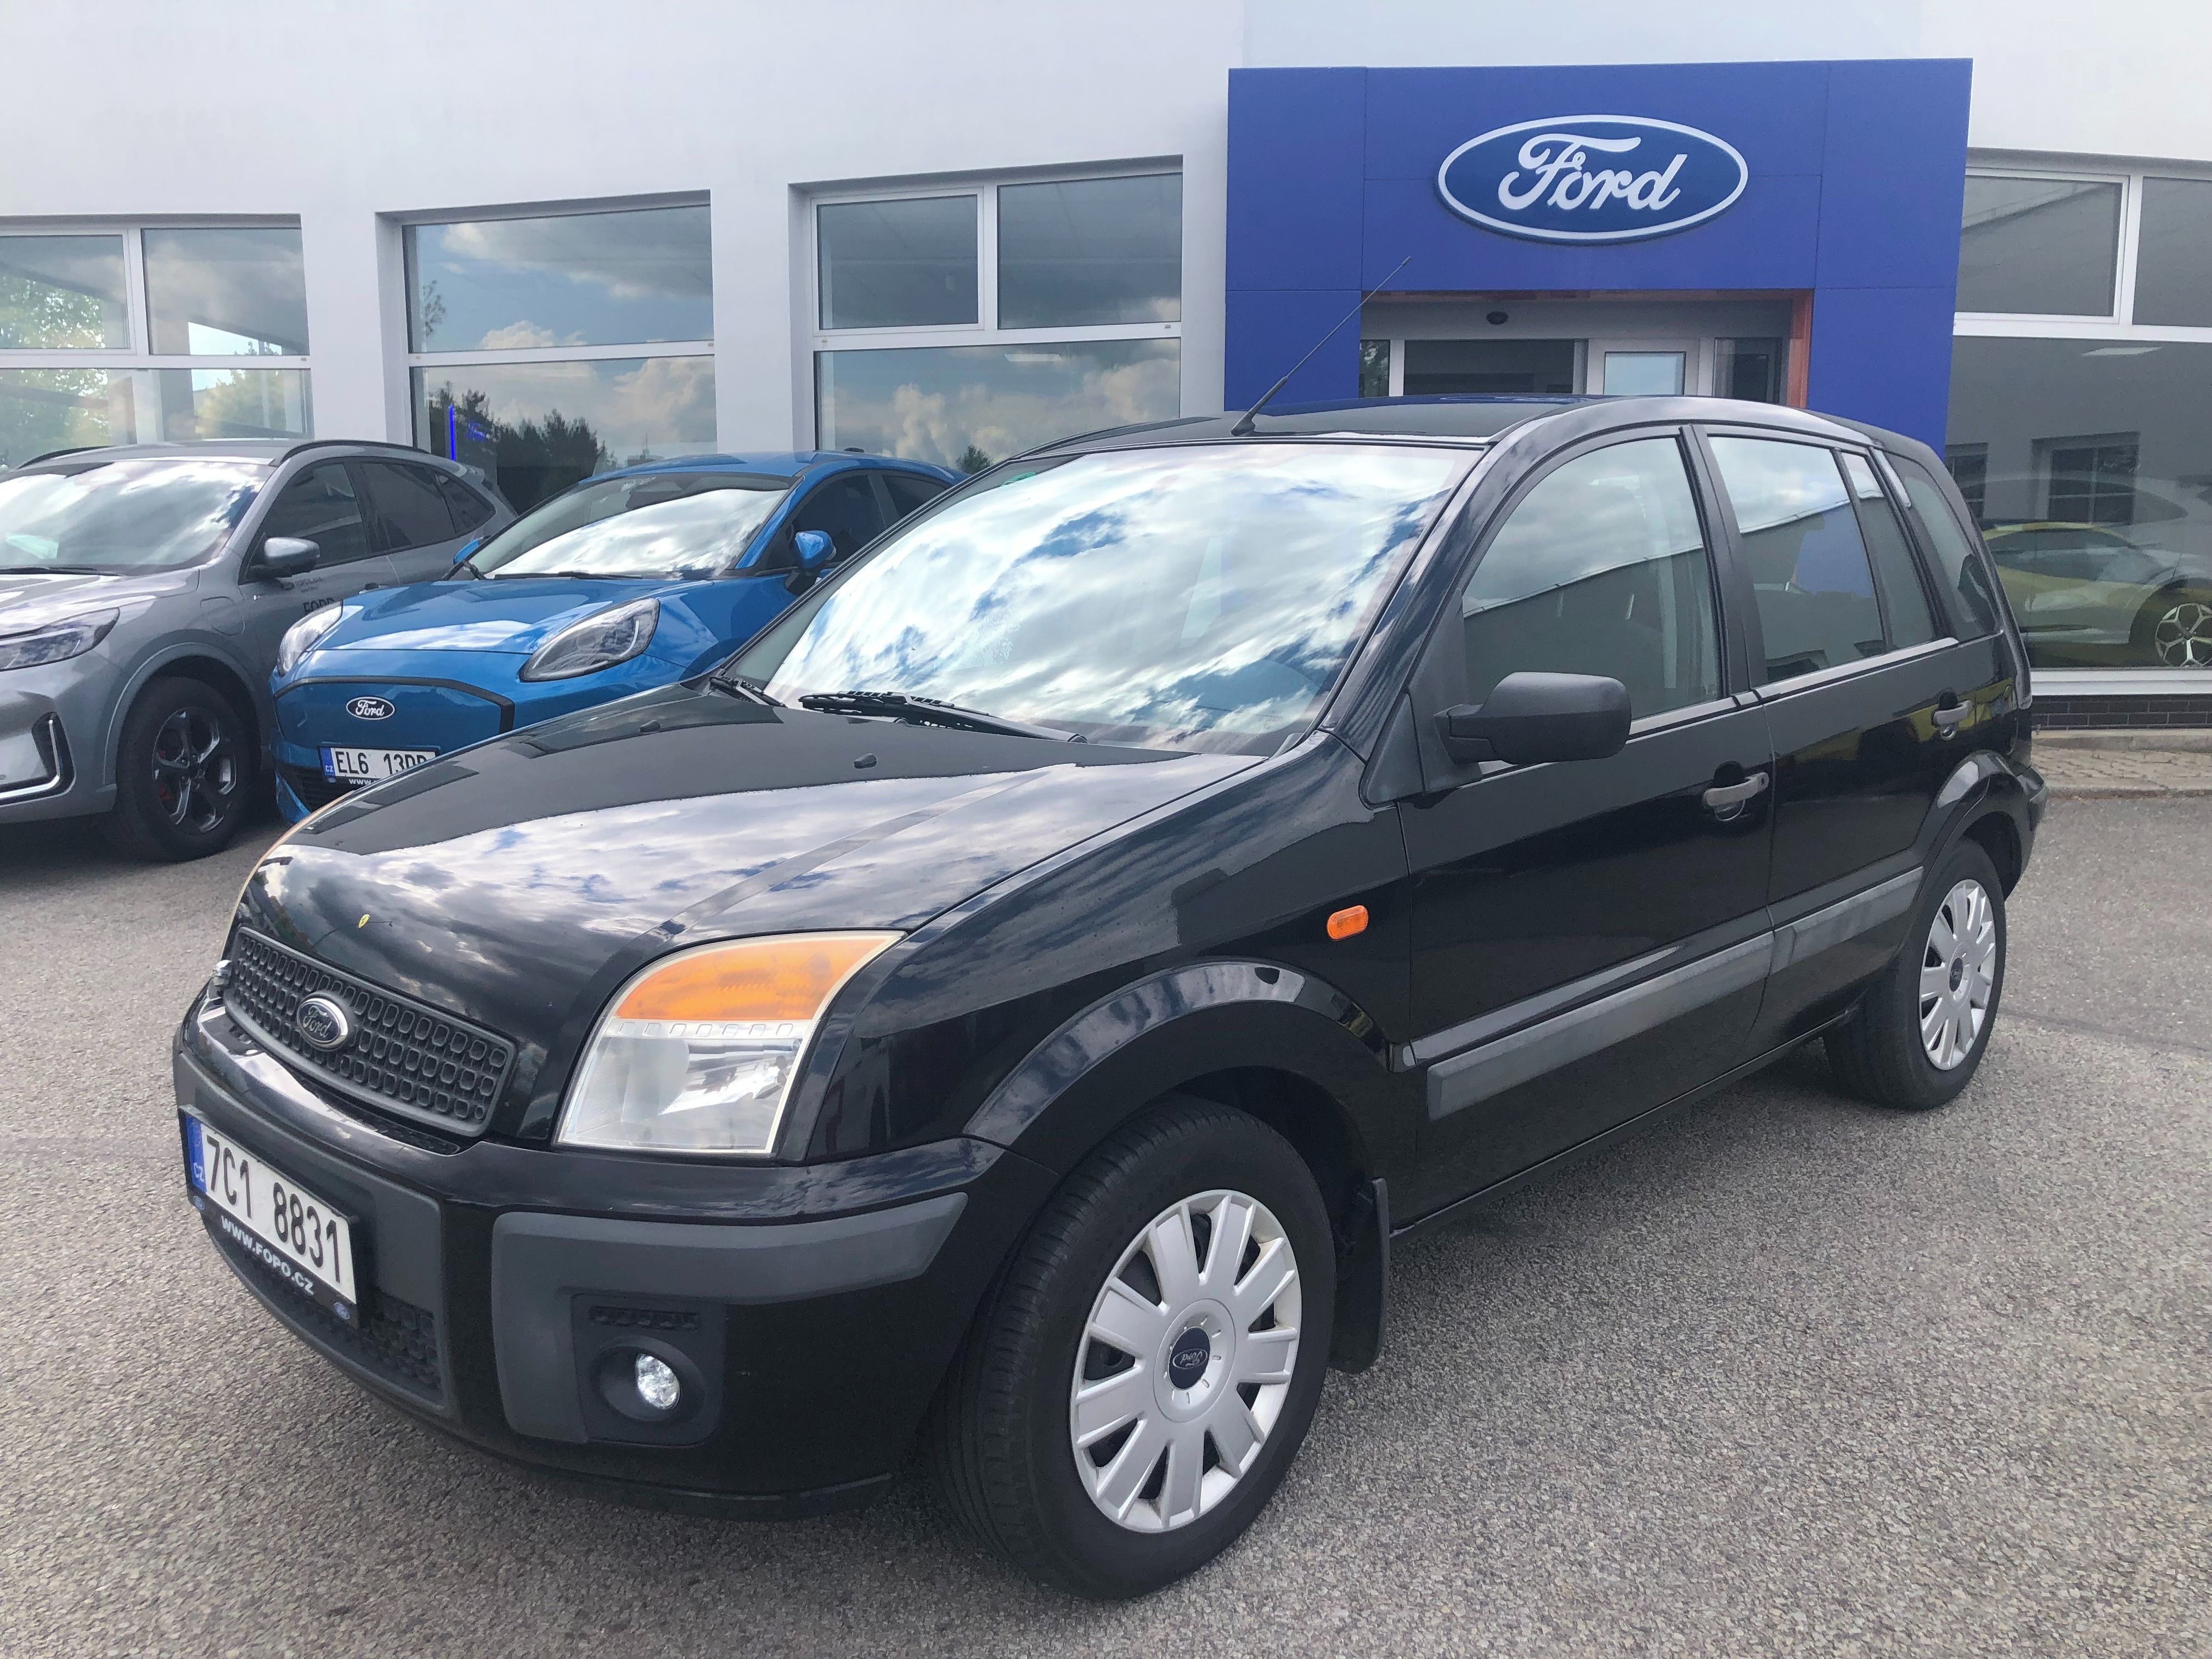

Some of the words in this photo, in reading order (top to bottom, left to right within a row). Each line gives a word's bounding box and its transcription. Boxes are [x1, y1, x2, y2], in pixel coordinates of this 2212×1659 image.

[1498, 133, 1688, 211] Ford
[355, 699, 385, 716] Ford
[335, 751, 369, 775] EL6
[303, 1005, 332, 1038] Ford
[194, 1162, 204, 1182] CZ
[206, 1134, 252, 1219] 7C1
[273, 1182, 341, 1284] 8831
[1180, 1351, 1204, 1367] Ford
